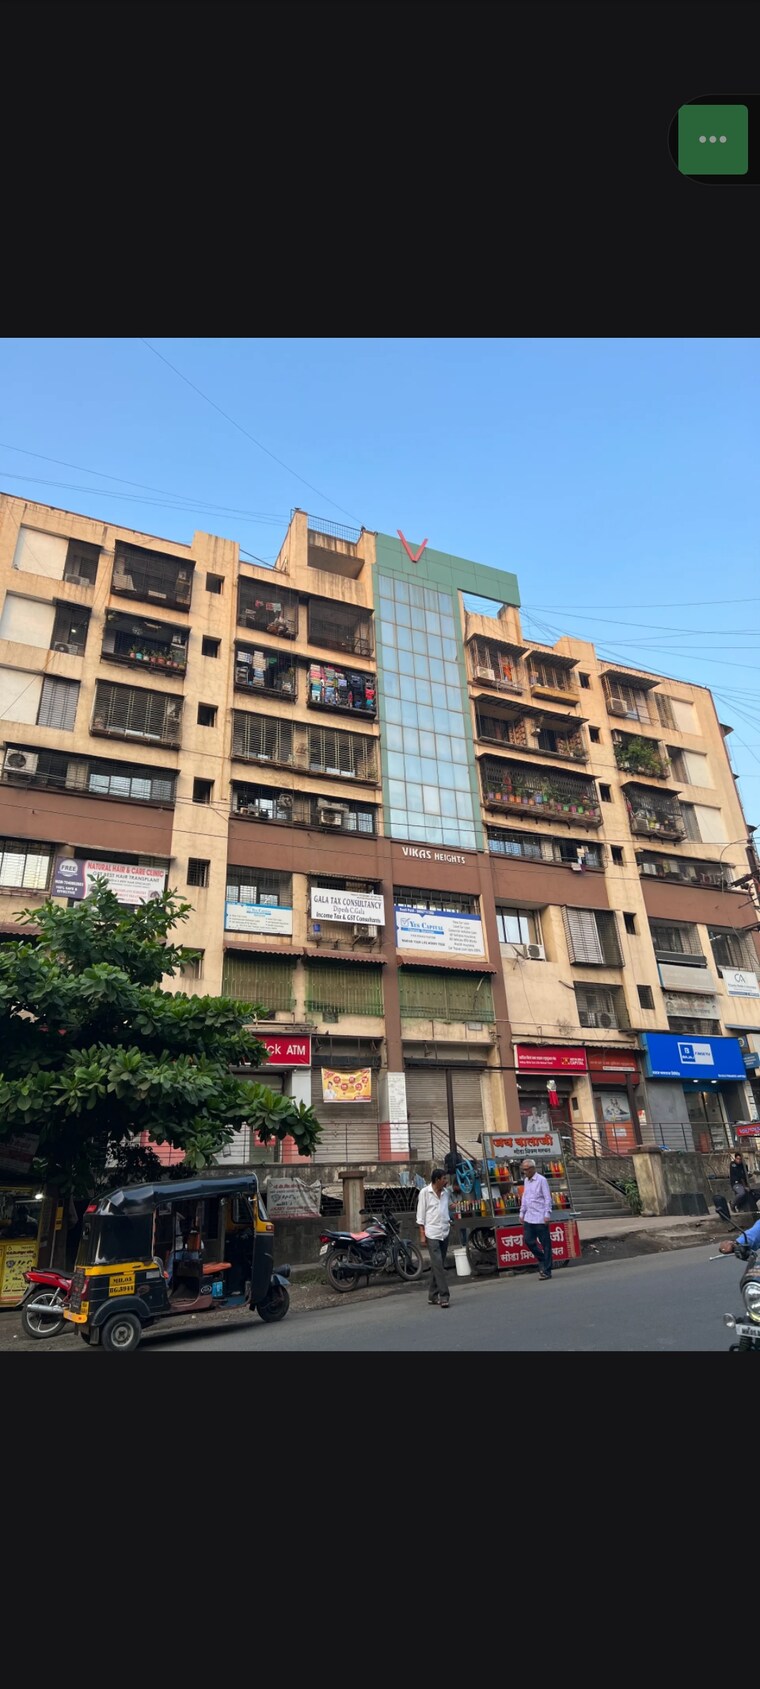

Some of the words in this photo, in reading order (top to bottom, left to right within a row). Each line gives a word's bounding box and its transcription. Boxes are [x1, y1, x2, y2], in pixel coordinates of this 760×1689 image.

[402, 846, 432, 860] VIKAS
[434, 852, 466, 864] HEIGHTS
[87, 862, 111, 872] NATURAL
[112, 865, 125, 873] HAIR
[131, 867, 145, 875] CARE
[146, 869, 164, 877] CLINIC
[129, 875, 160, 883] TRANSPLANT
[313, 895, 329, 904] GALA
[330, 896, 342, 905] TAX
[343, 898, 382, 909] CONSULTANCY
[333, 905, 349, 914] Dipesh
[264, 1043, 282, 1055] ick
[286, 1044, 306, 1056] ATM
[501, 1234, 524, 1247] जय
[501, 1251, 519, 1262] सोडा
